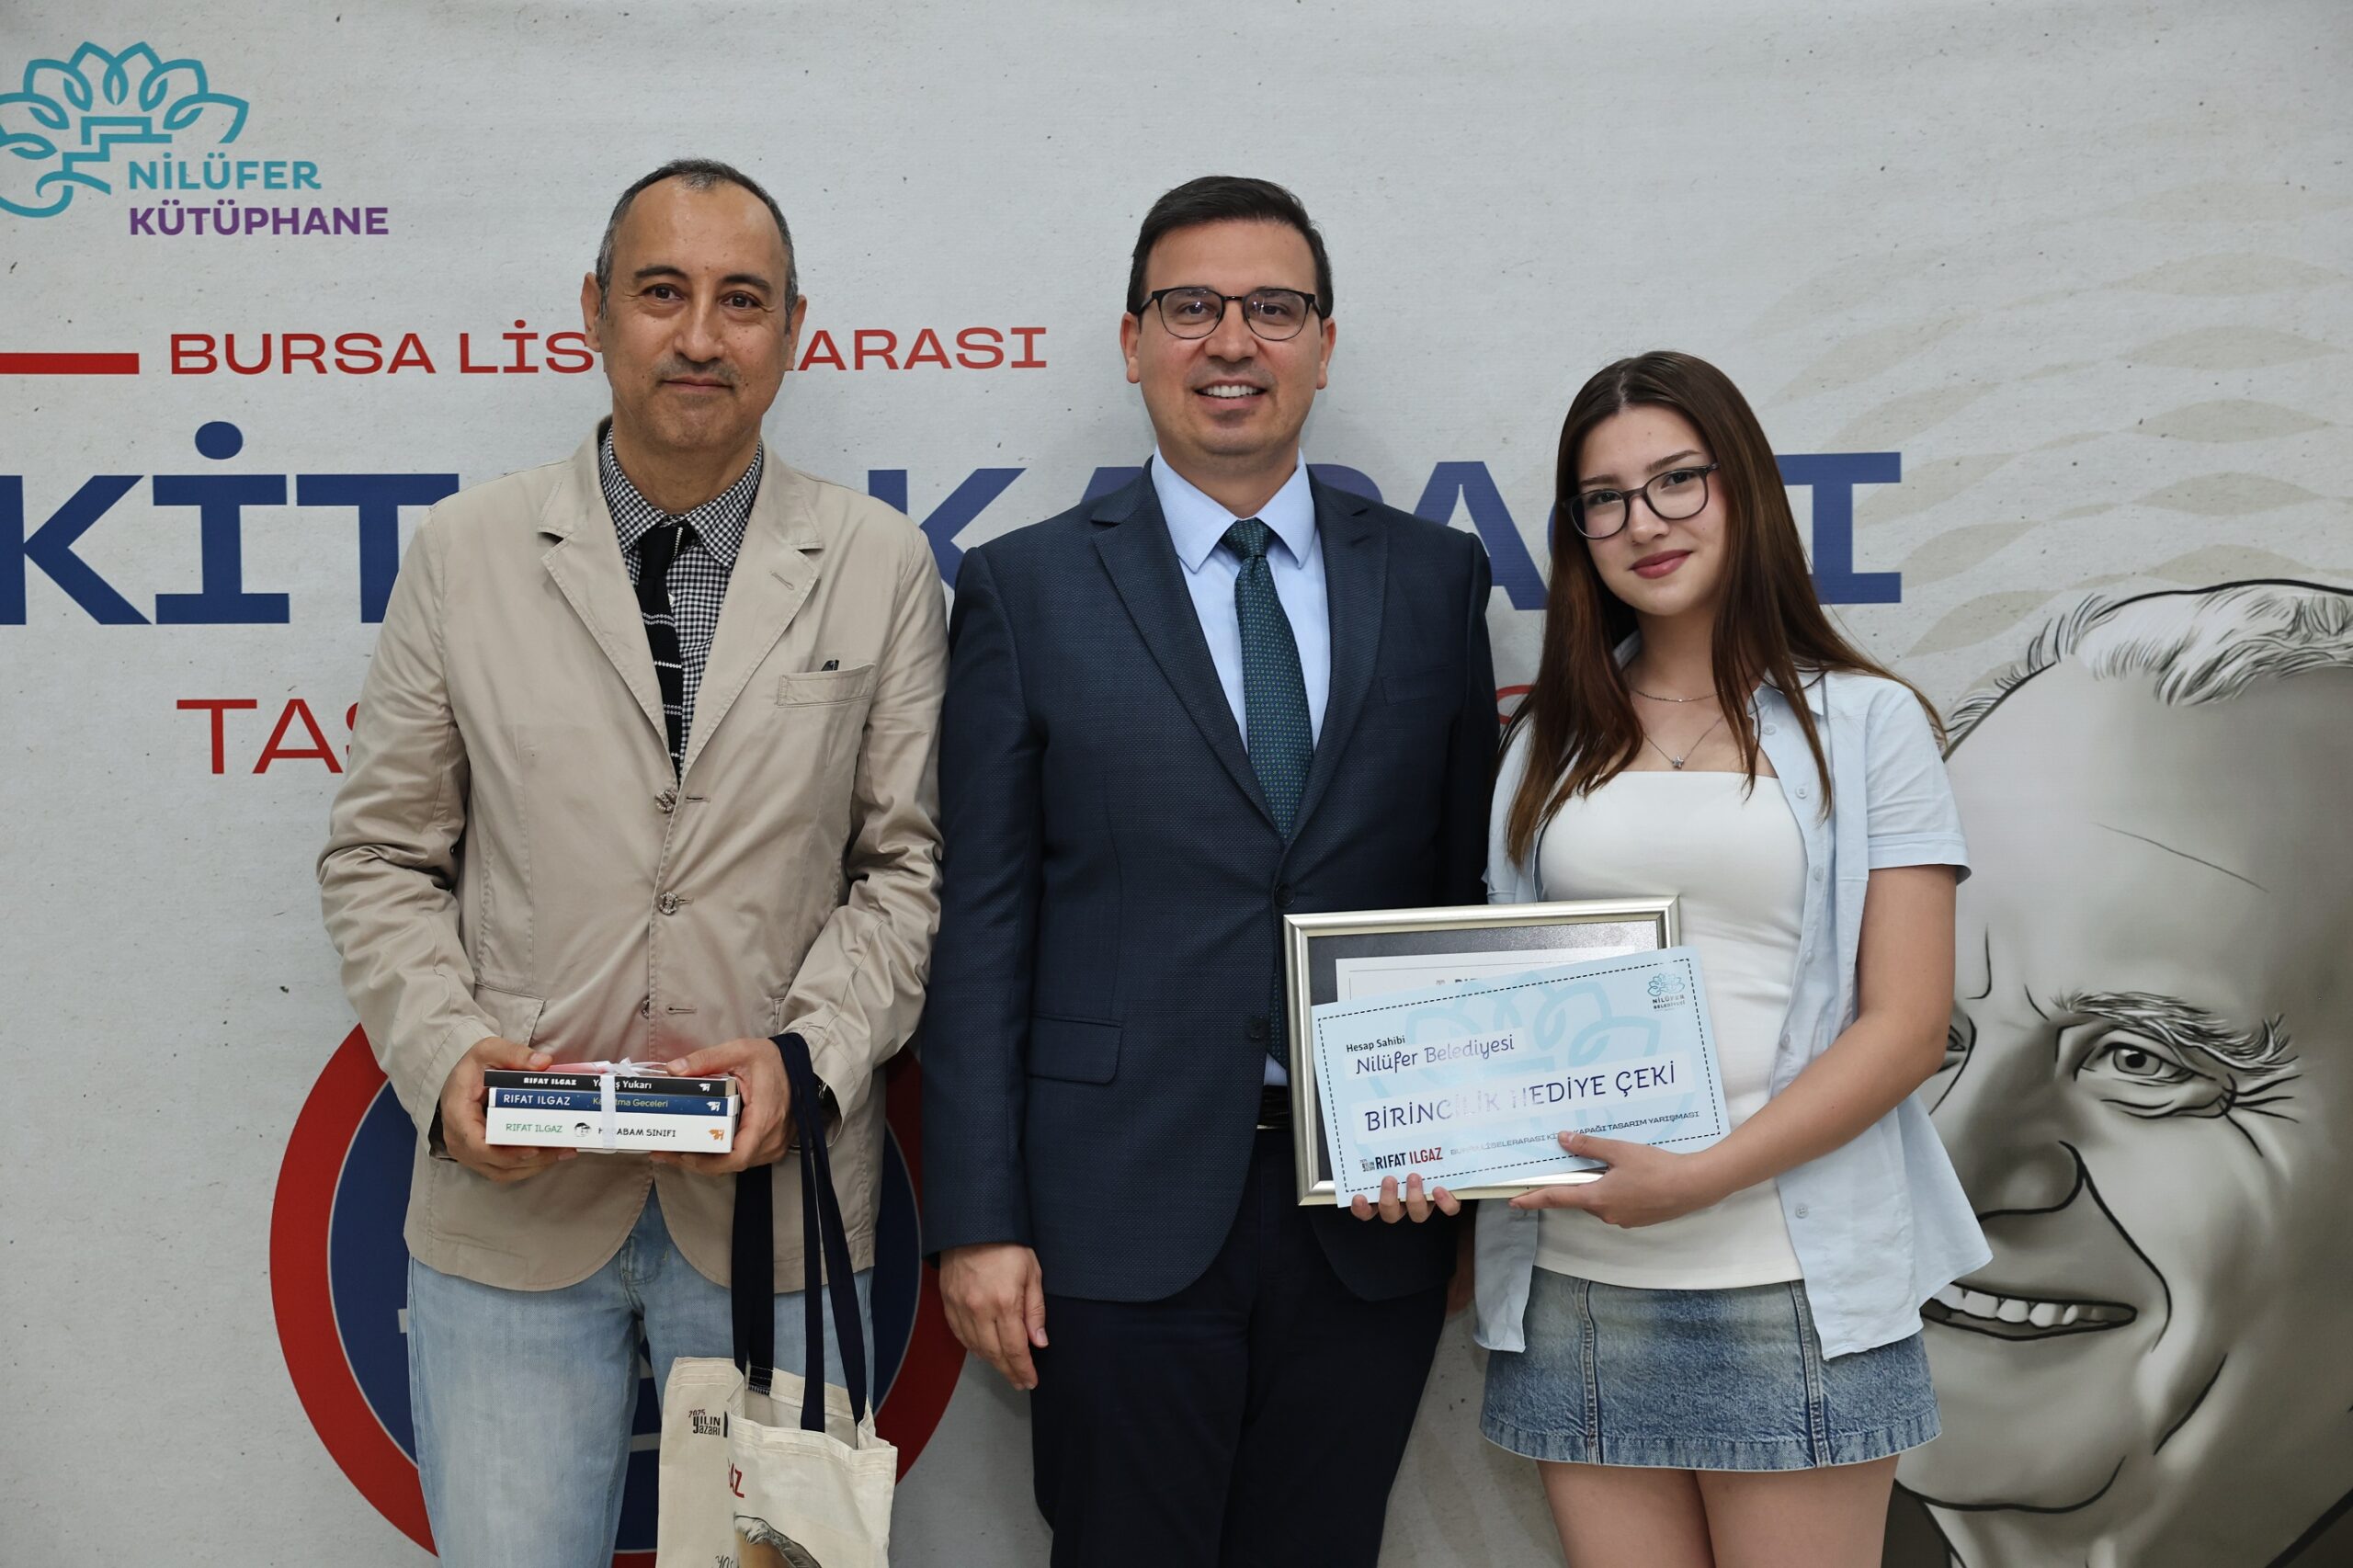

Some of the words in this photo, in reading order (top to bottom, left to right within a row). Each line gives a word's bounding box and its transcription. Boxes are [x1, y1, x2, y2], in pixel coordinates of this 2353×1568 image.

[129, 152, 322, 189] NİLÜFER
[130, 199, 389, 235] KÜTÜPHANE
[170, 333, 437, 375] BURSA
[460, 319, 1047, 374] LİSARASI
[0, 421, 460, 625] KİT
[1347, 1042, 1375, 1052] Hesap
[1377, 1035, 1405, 1048] Sahibi
[1356, 1051, 1419, 1074] Nilüfer
[1424, 1034, 1515, 1063] Belediyesi
[622, 1080, 652, 1089] Yukarı
[1616, 1061, 1675, 1097] ÇEKİ
[503, 1094, 533, 1104] RIFAT
[537, 1095, 571, 1106] ILGAZ
[632, 1098, 669, 1108] Geceleri
[506, 1123, 533, 1132] RIFAT
[535, 1124, 563, 1133] ILGAZ
[598, 1128, 644, 1137] HABAM
[646, 1129, 676, 1138] SINIFI
[1375, 1153, 1406, 1170] RIFAT
[1409, 1147, 1443, 1165] ILGAZ
[1608, 1119, 1647, 1131] TASARIM
[1648, 1110, 1699, 1124] YARIŞMASI
